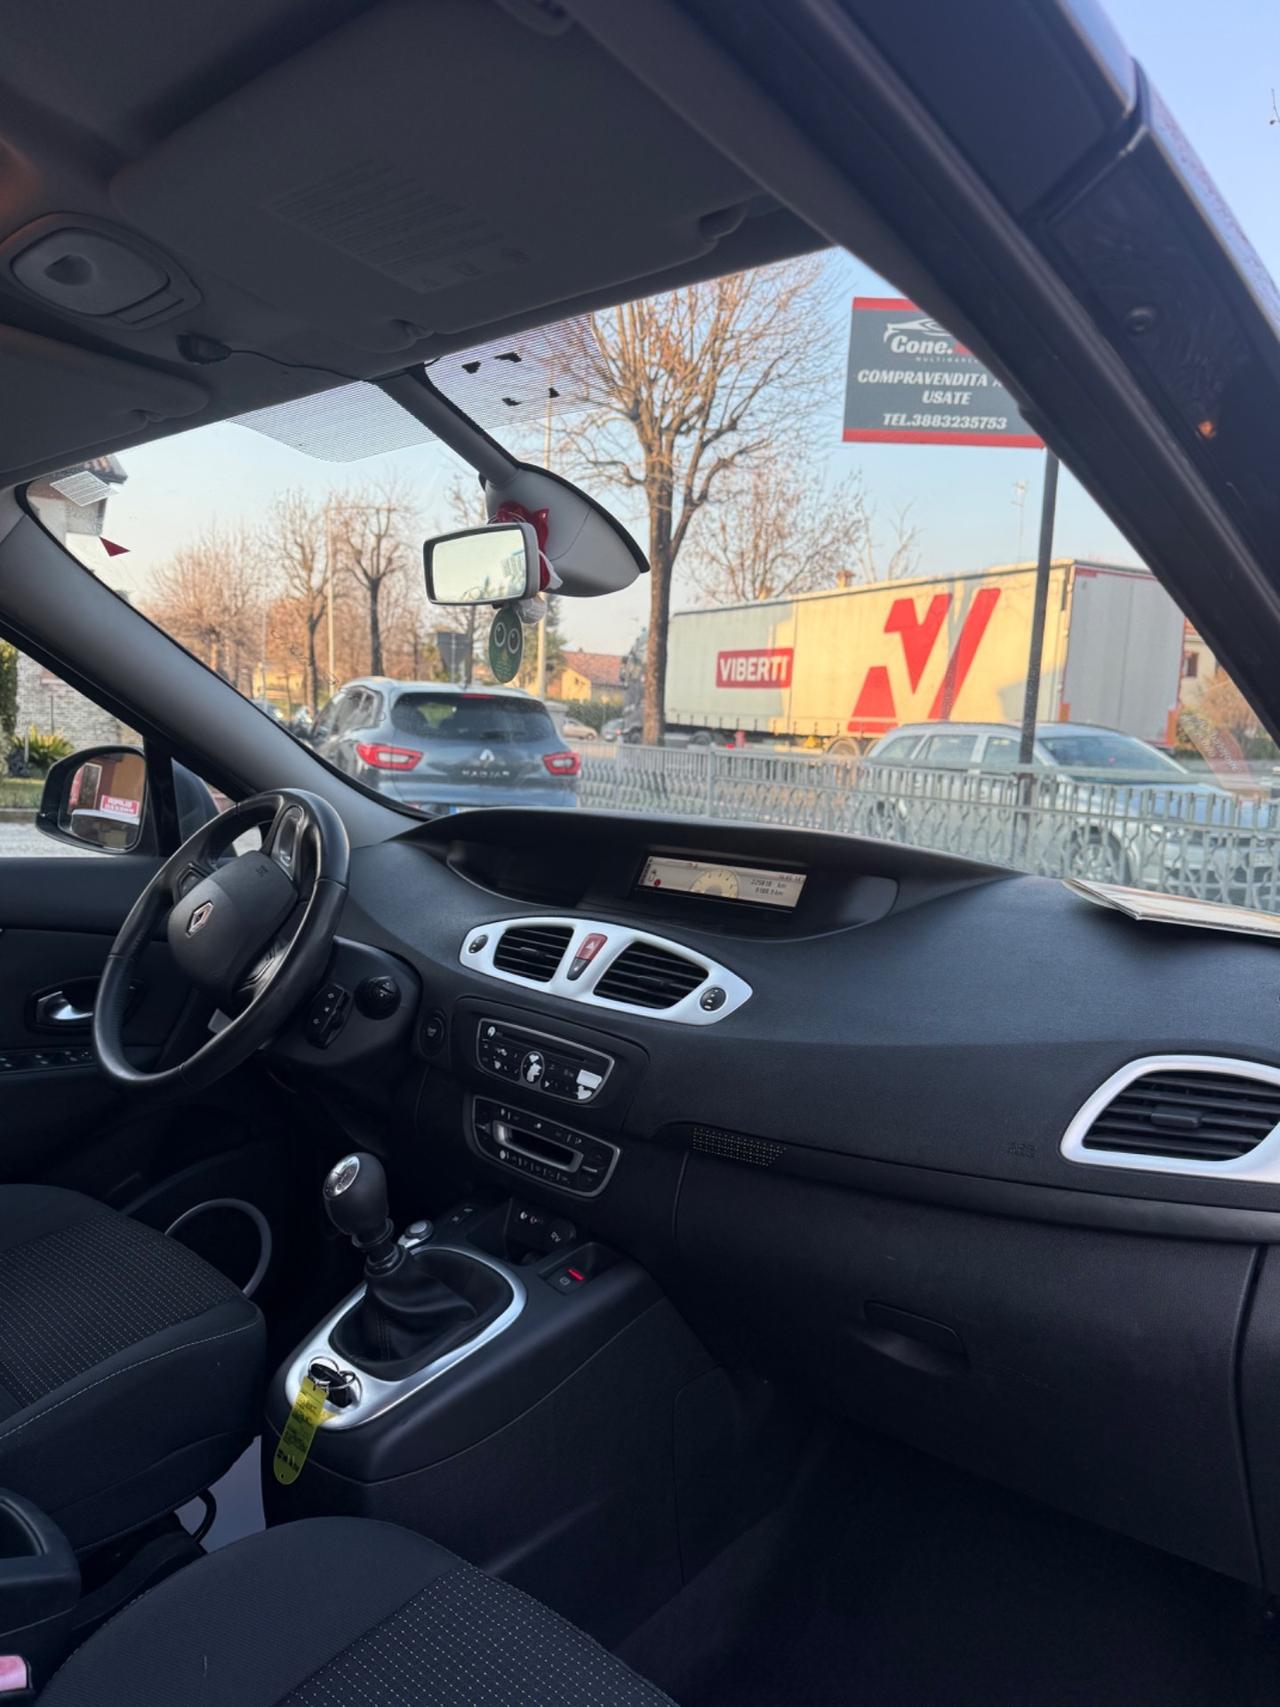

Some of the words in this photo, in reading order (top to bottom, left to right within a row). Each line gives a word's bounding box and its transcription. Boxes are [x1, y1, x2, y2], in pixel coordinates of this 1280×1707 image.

[857, 369, 988, 387] COMPRAVENDITA
[922, 390, 972, 405] USATE
[720, 656, 788, 682] VIBERTI
